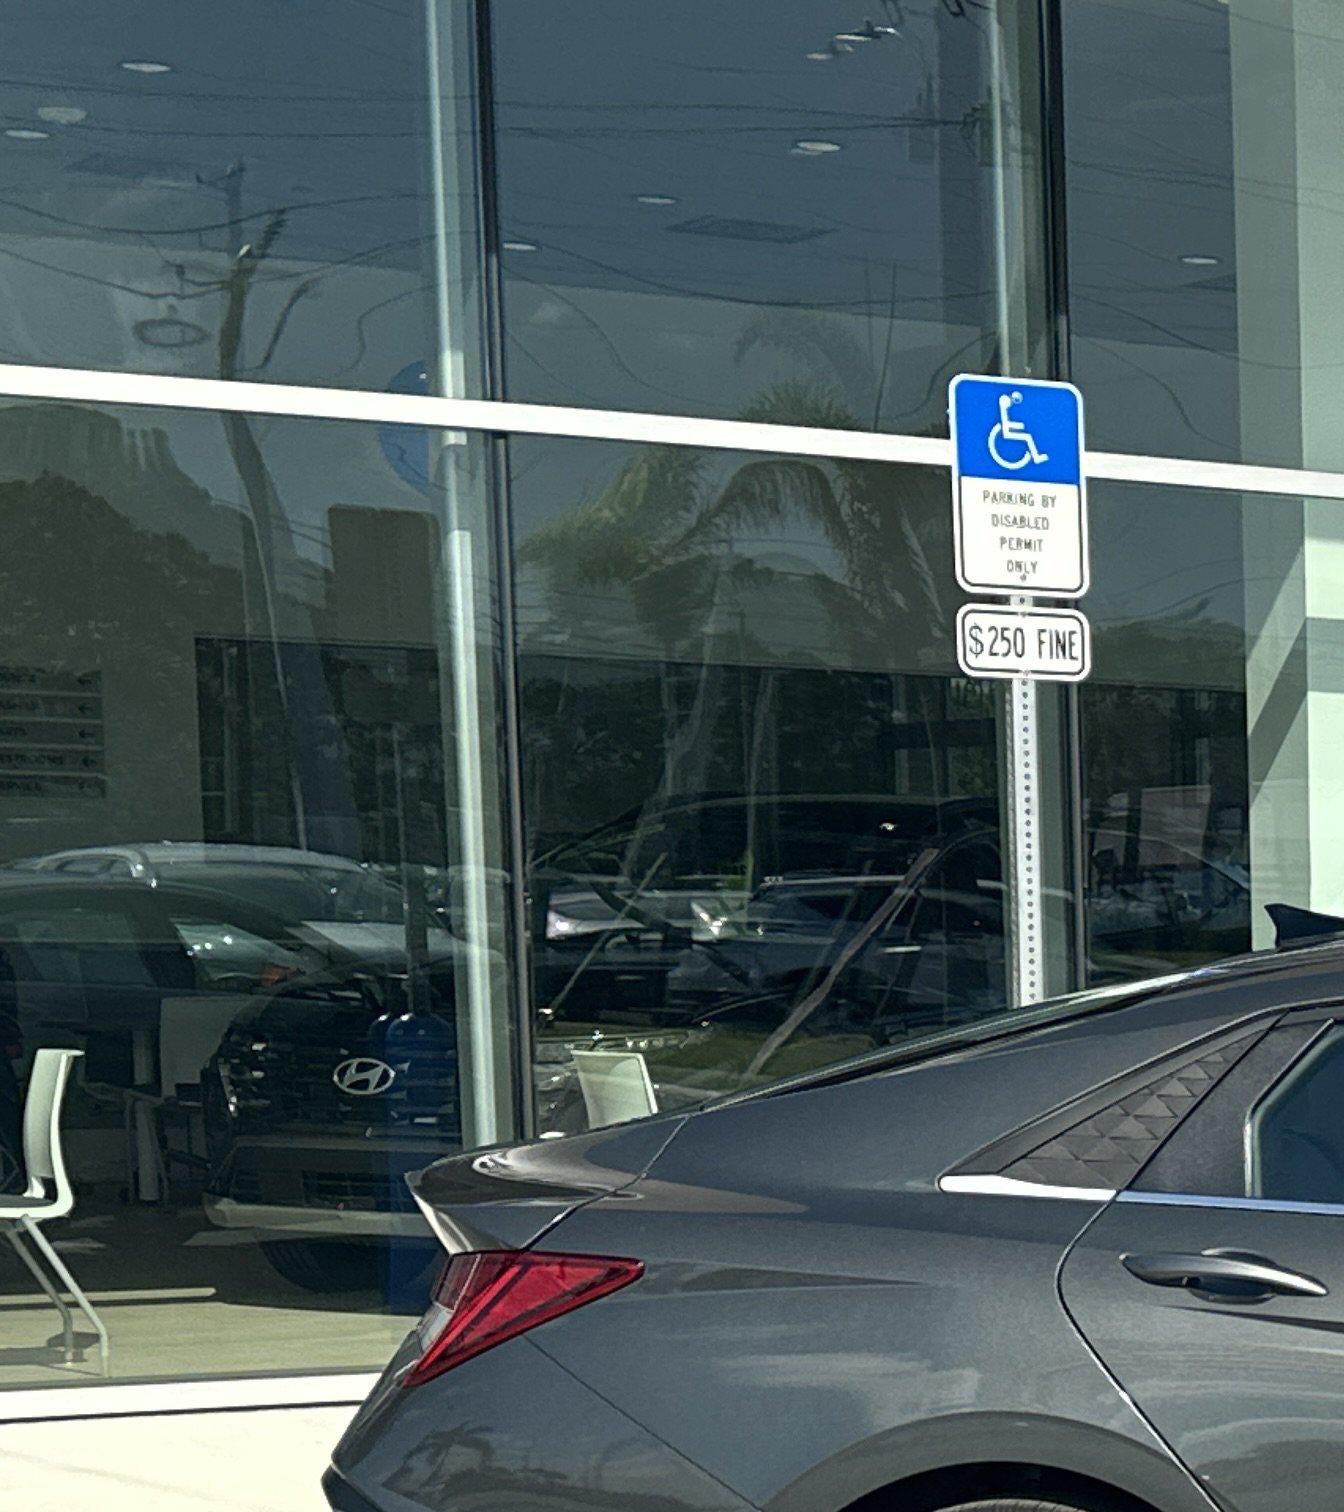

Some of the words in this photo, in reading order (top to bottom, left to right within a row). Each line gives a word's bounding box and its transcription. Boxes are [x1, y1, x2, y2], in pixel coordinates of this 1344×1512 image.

[983, 490, 1034, 507] PARKING
[1041, 494, 1057, 508] BY
[991, 513, 1049, 530] DISABLED
[999, 536, 1043, 552] PERMIT
[1006, 559, 1037, 574] ONLY
[969, 622, 1025, 659] $250
[1037, 628, 1079, 660] FINE
